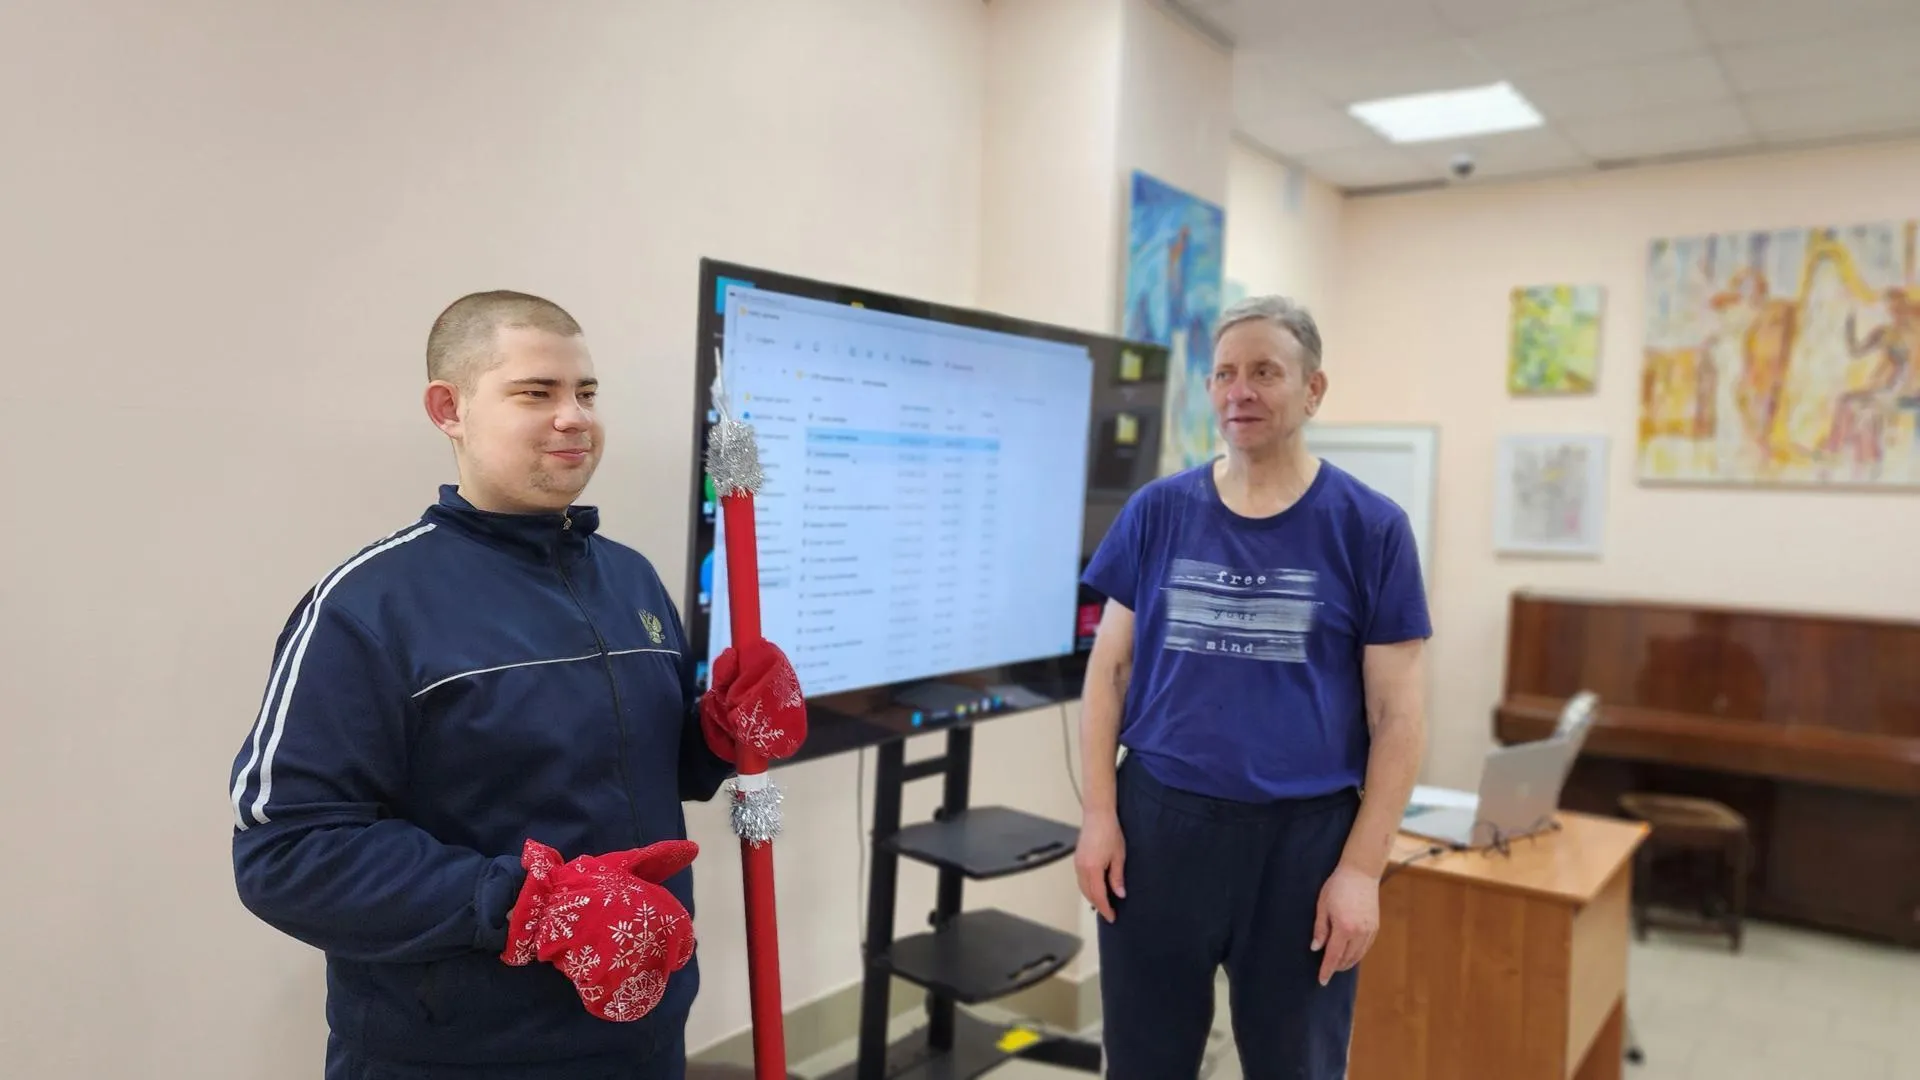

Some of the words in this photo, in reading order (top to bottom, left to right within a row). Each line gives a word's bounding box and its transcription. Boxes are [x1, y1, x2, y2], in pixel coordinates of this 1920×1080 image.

[1216, 570, 1267, 585] free
[1214, 608, 1257, 621] your
[1206, 639, 1254, 654] mind
